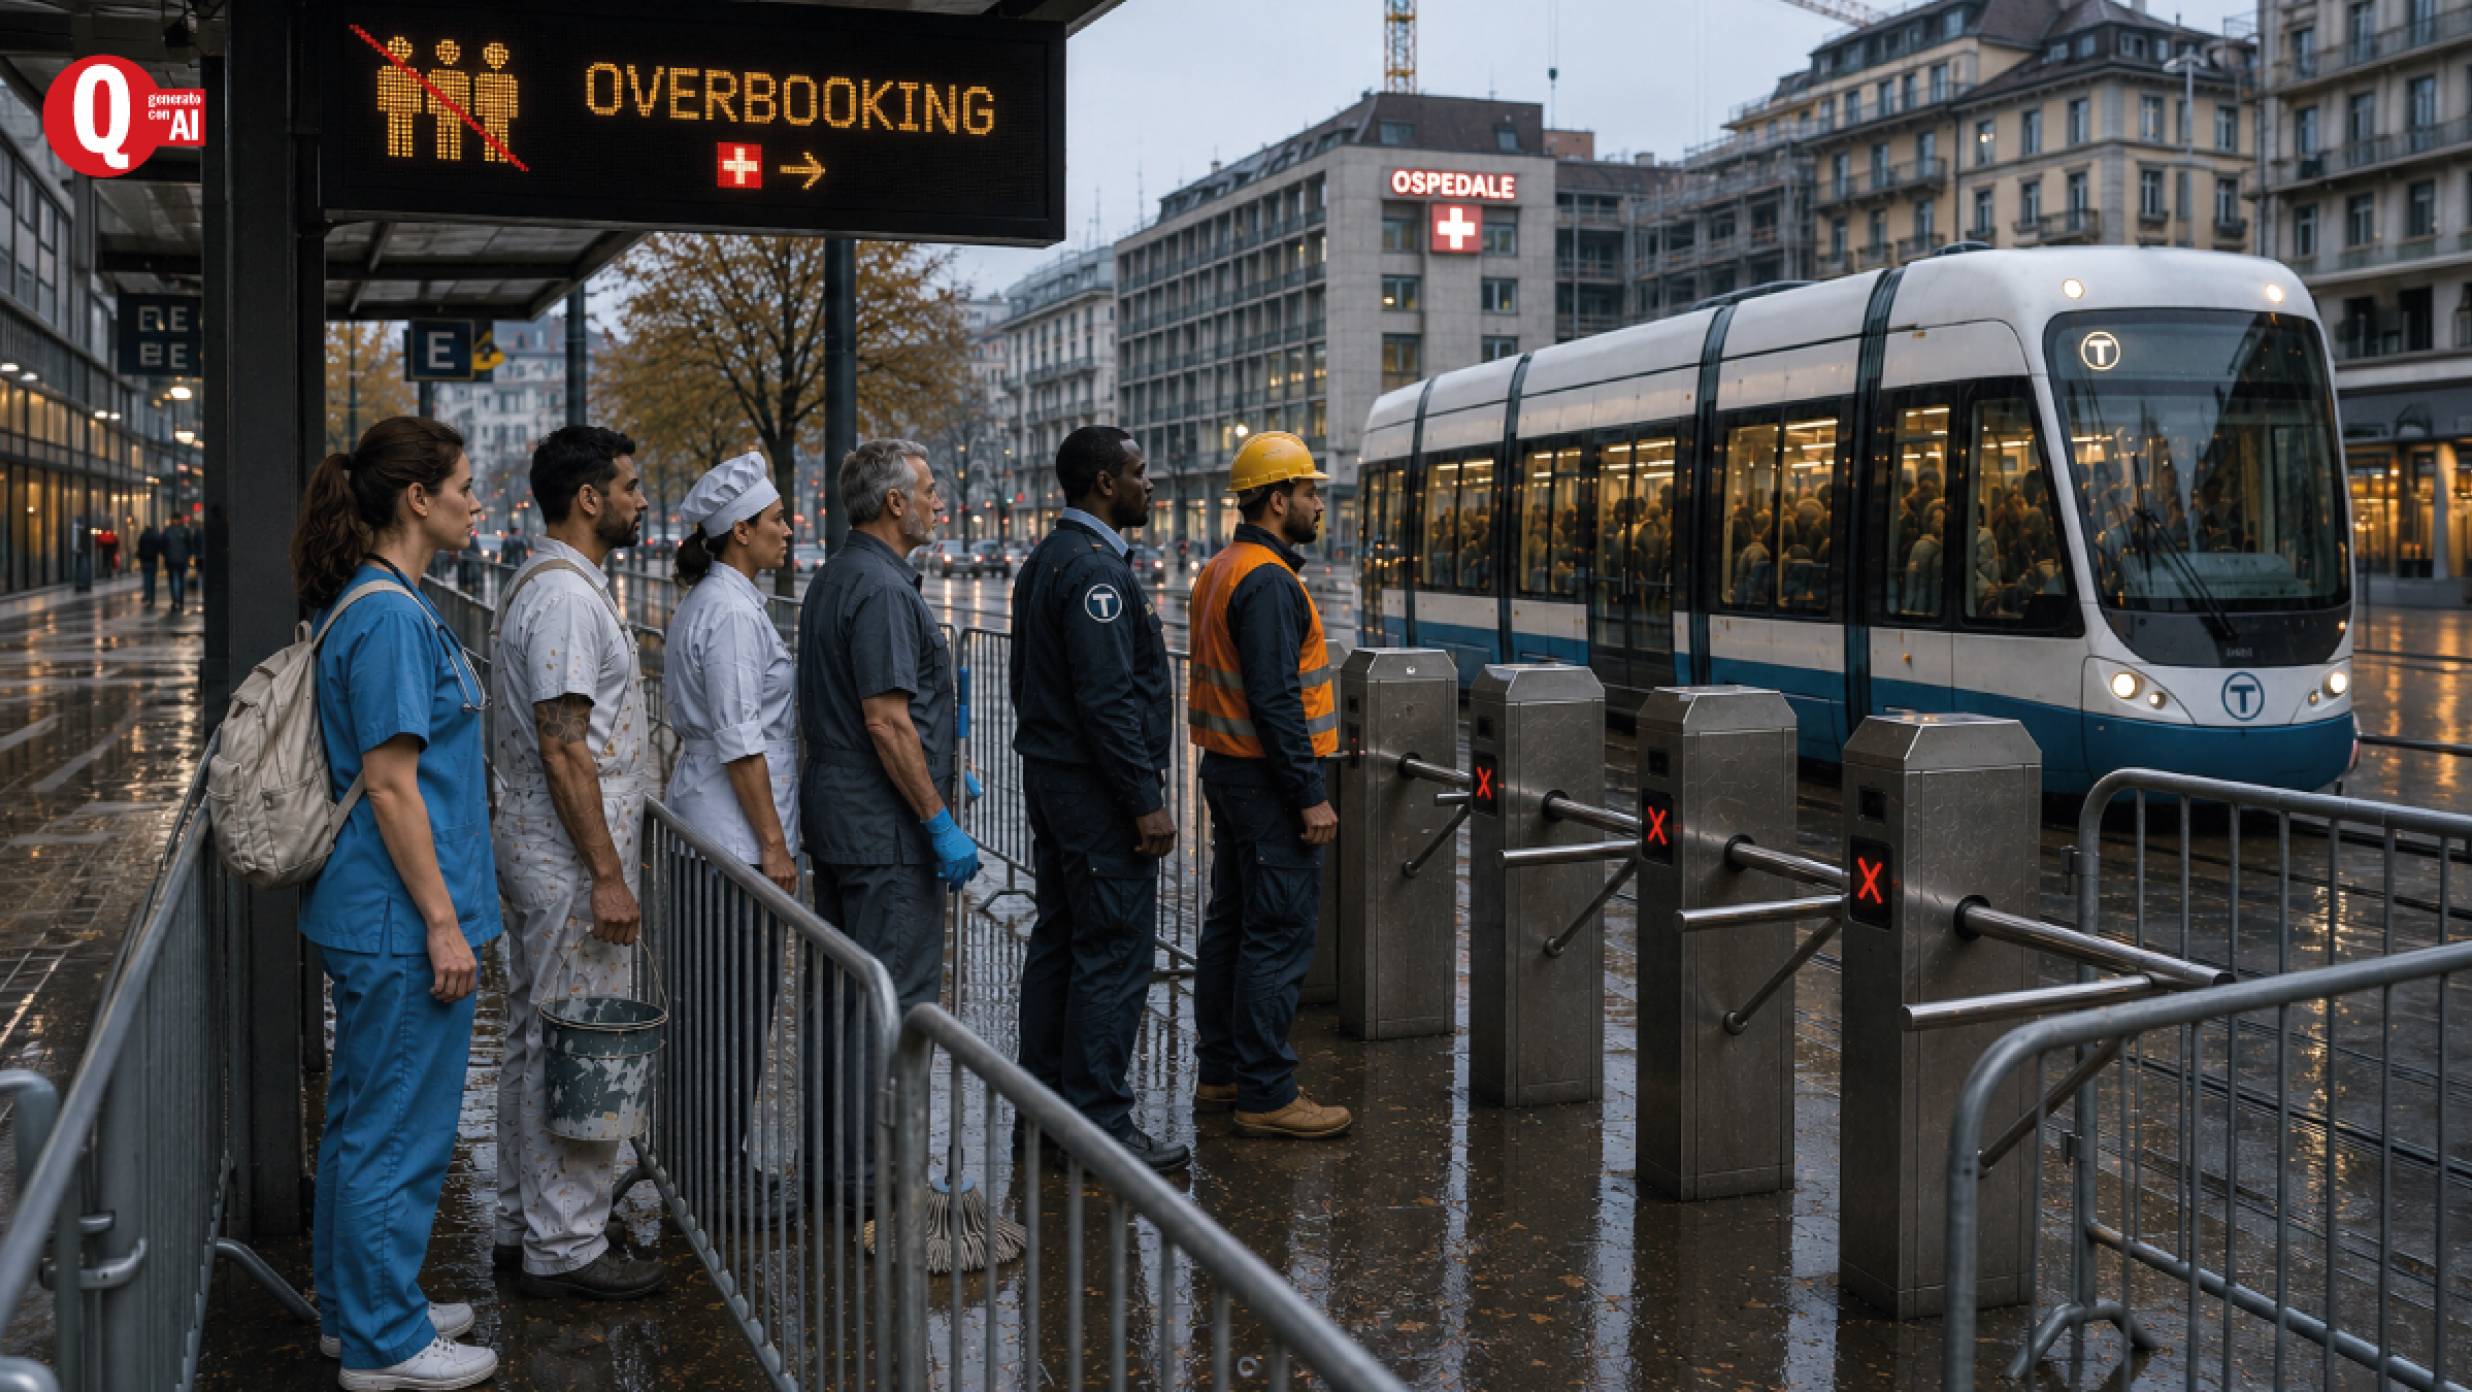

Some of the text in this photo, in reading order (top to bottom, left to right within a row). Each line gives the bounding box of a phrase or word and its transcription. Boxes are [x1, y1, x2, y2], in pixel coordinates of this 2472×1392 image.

[586, 62, 995, 136] OVERBOOKING
[1392, 169, 1515, 200] OSPEDALE
[428, 331, 455, 368] E
[2089, 339, 2112, 365] T
[1092, 593, 1113, 617] T
[2230, 684, 2256, 713] T
